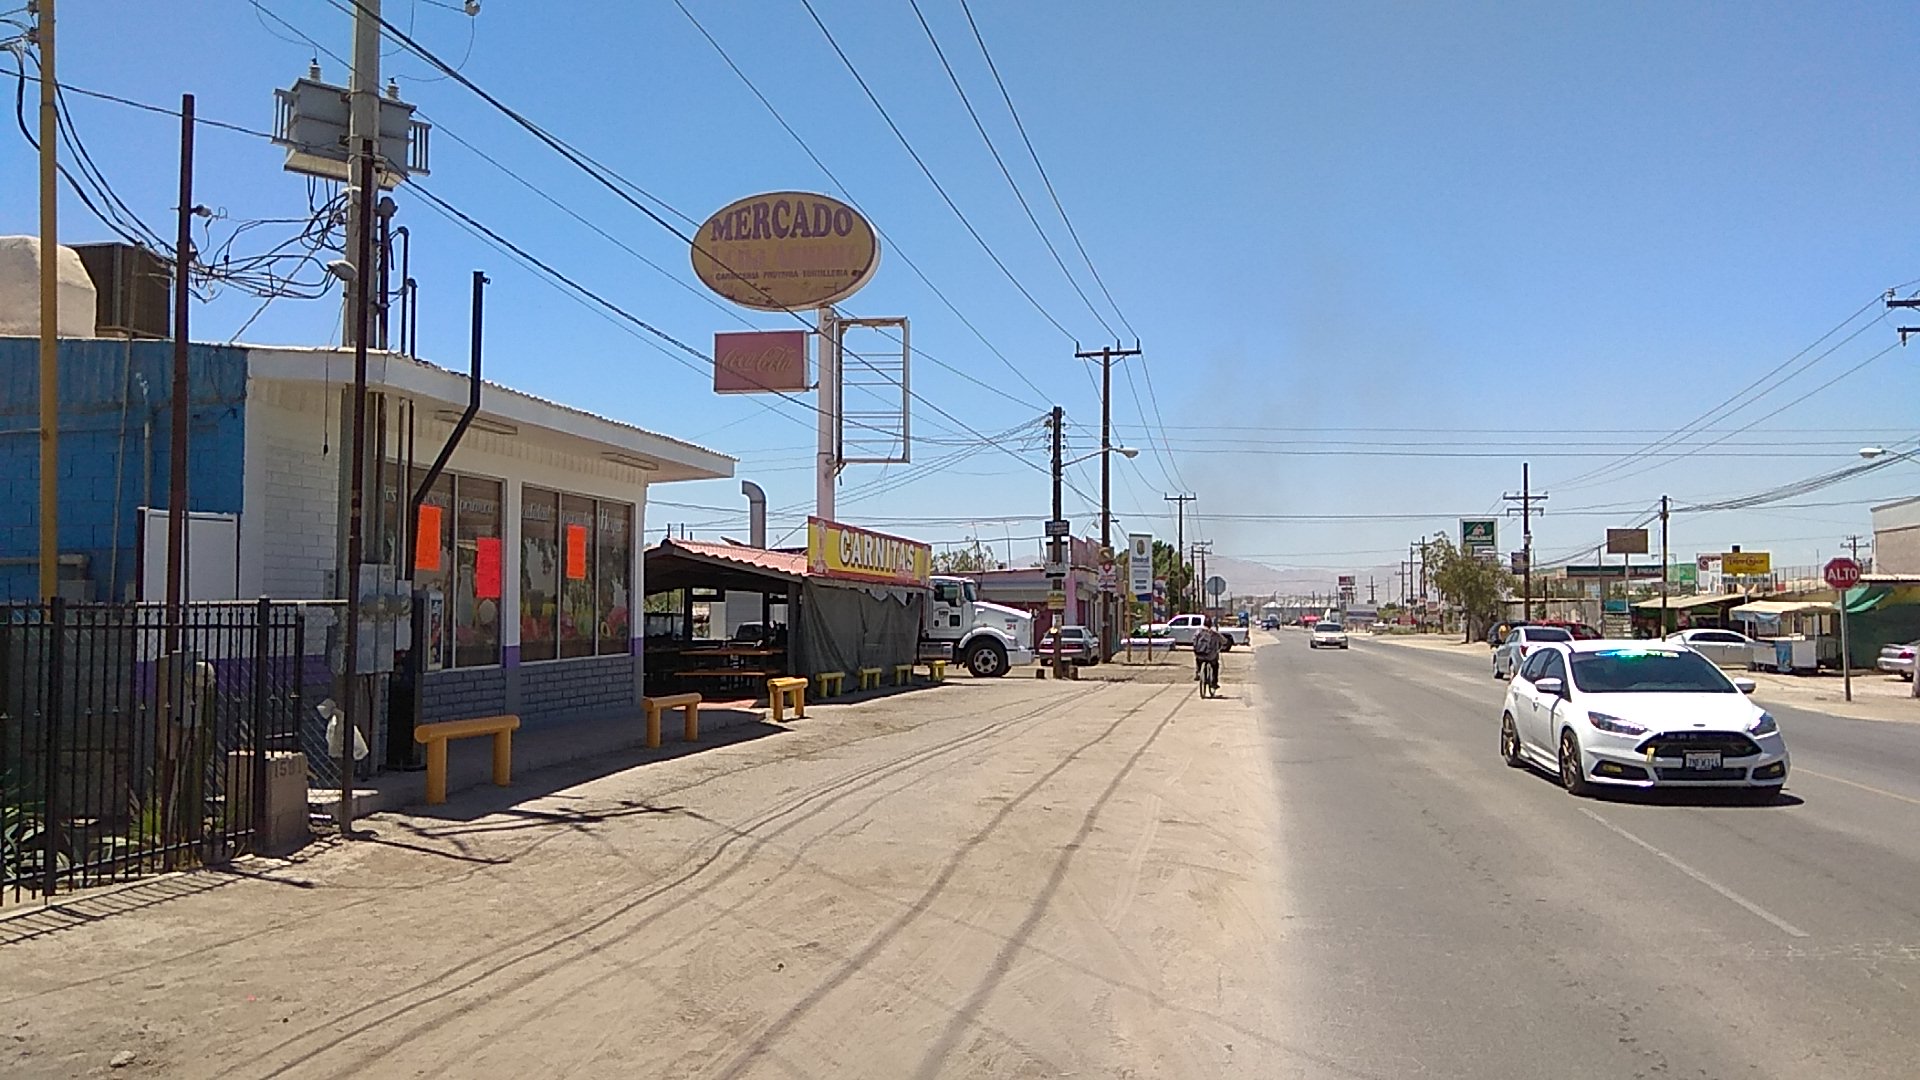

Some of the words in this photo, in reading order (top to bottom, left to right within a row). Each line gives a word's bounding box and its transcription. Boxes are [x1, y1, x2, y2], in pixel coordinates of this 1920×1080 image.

[711, 199, 854, 242] MERCADO
[840, 527, 915, 571] CARNITAS
[1827, 567, 1858, 581] ALTO
